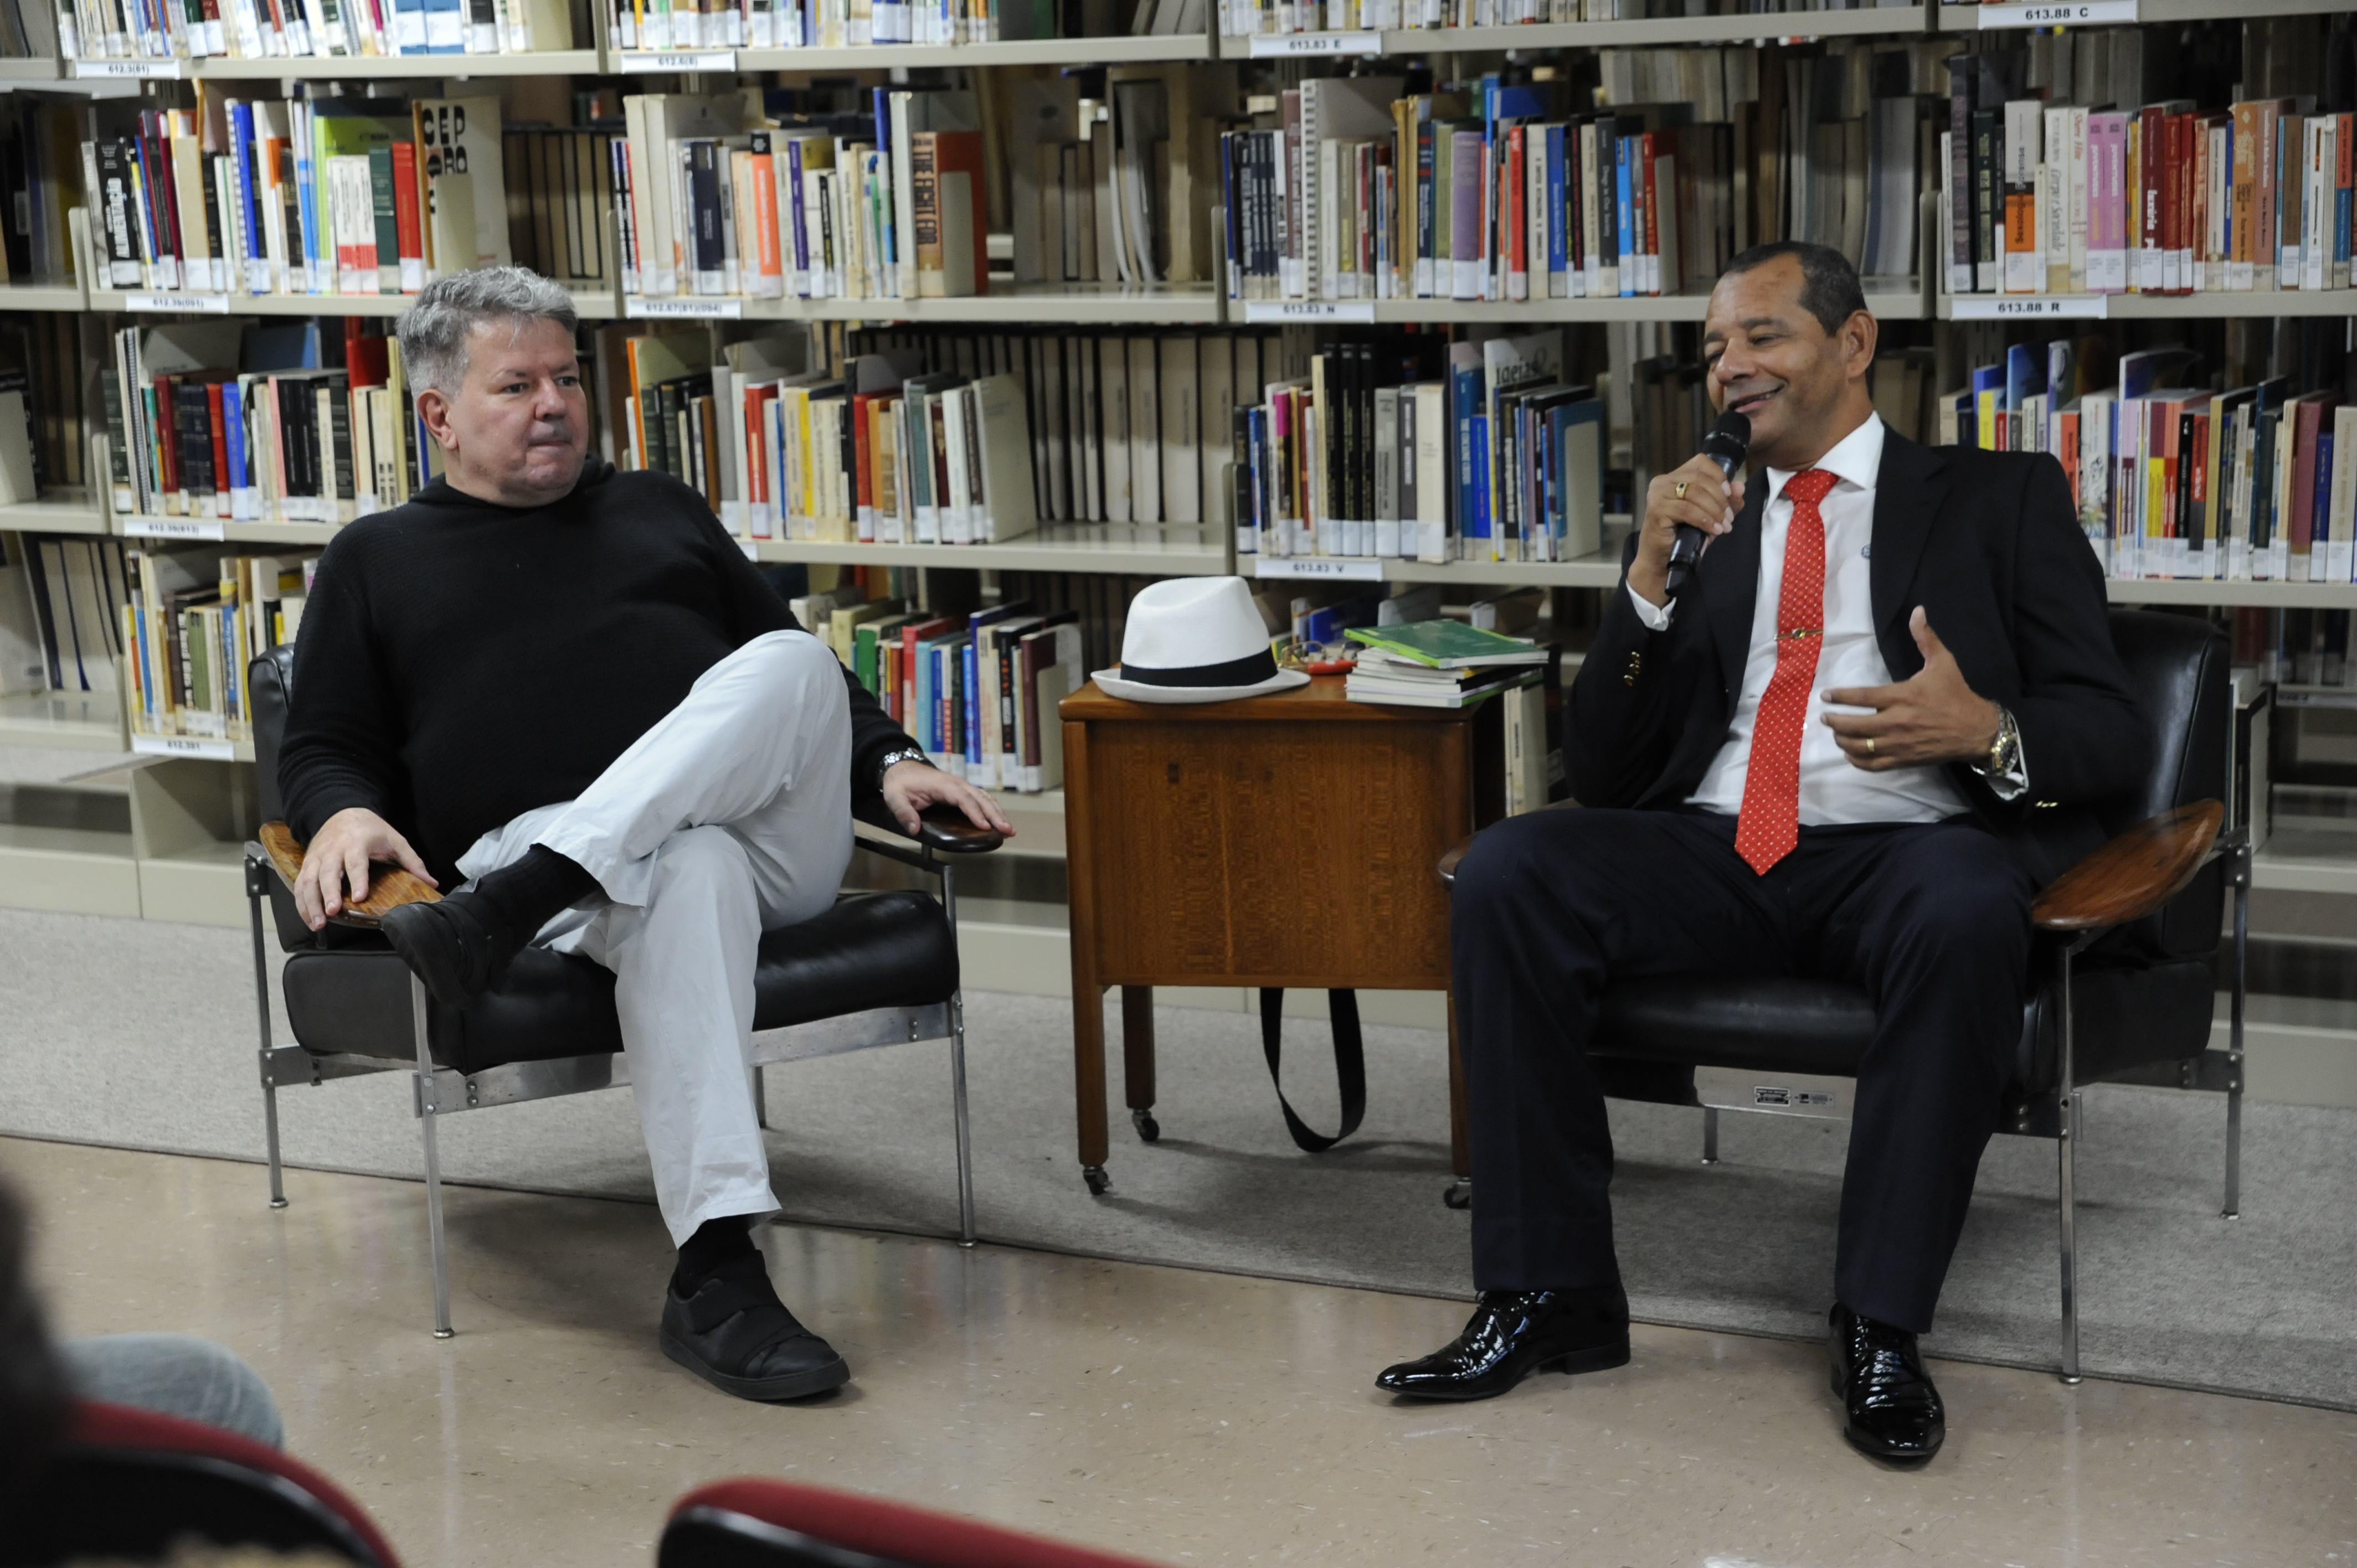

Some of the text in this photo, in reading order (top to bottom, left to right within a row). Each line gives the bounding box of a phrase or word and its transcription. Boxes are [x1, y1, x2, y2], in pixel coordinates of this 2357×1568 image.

[2025, 7, 2088, 20] 613.88 C
[1289, 39, 1340, 50] 613.83 E
[423, 104, 466, 146] CEP
[1284, 305, 1320, 314] 613.83
[1998, 302, 2060, 312] 613.88 R
[1293, 563, 1344, 572] 613.83 V
